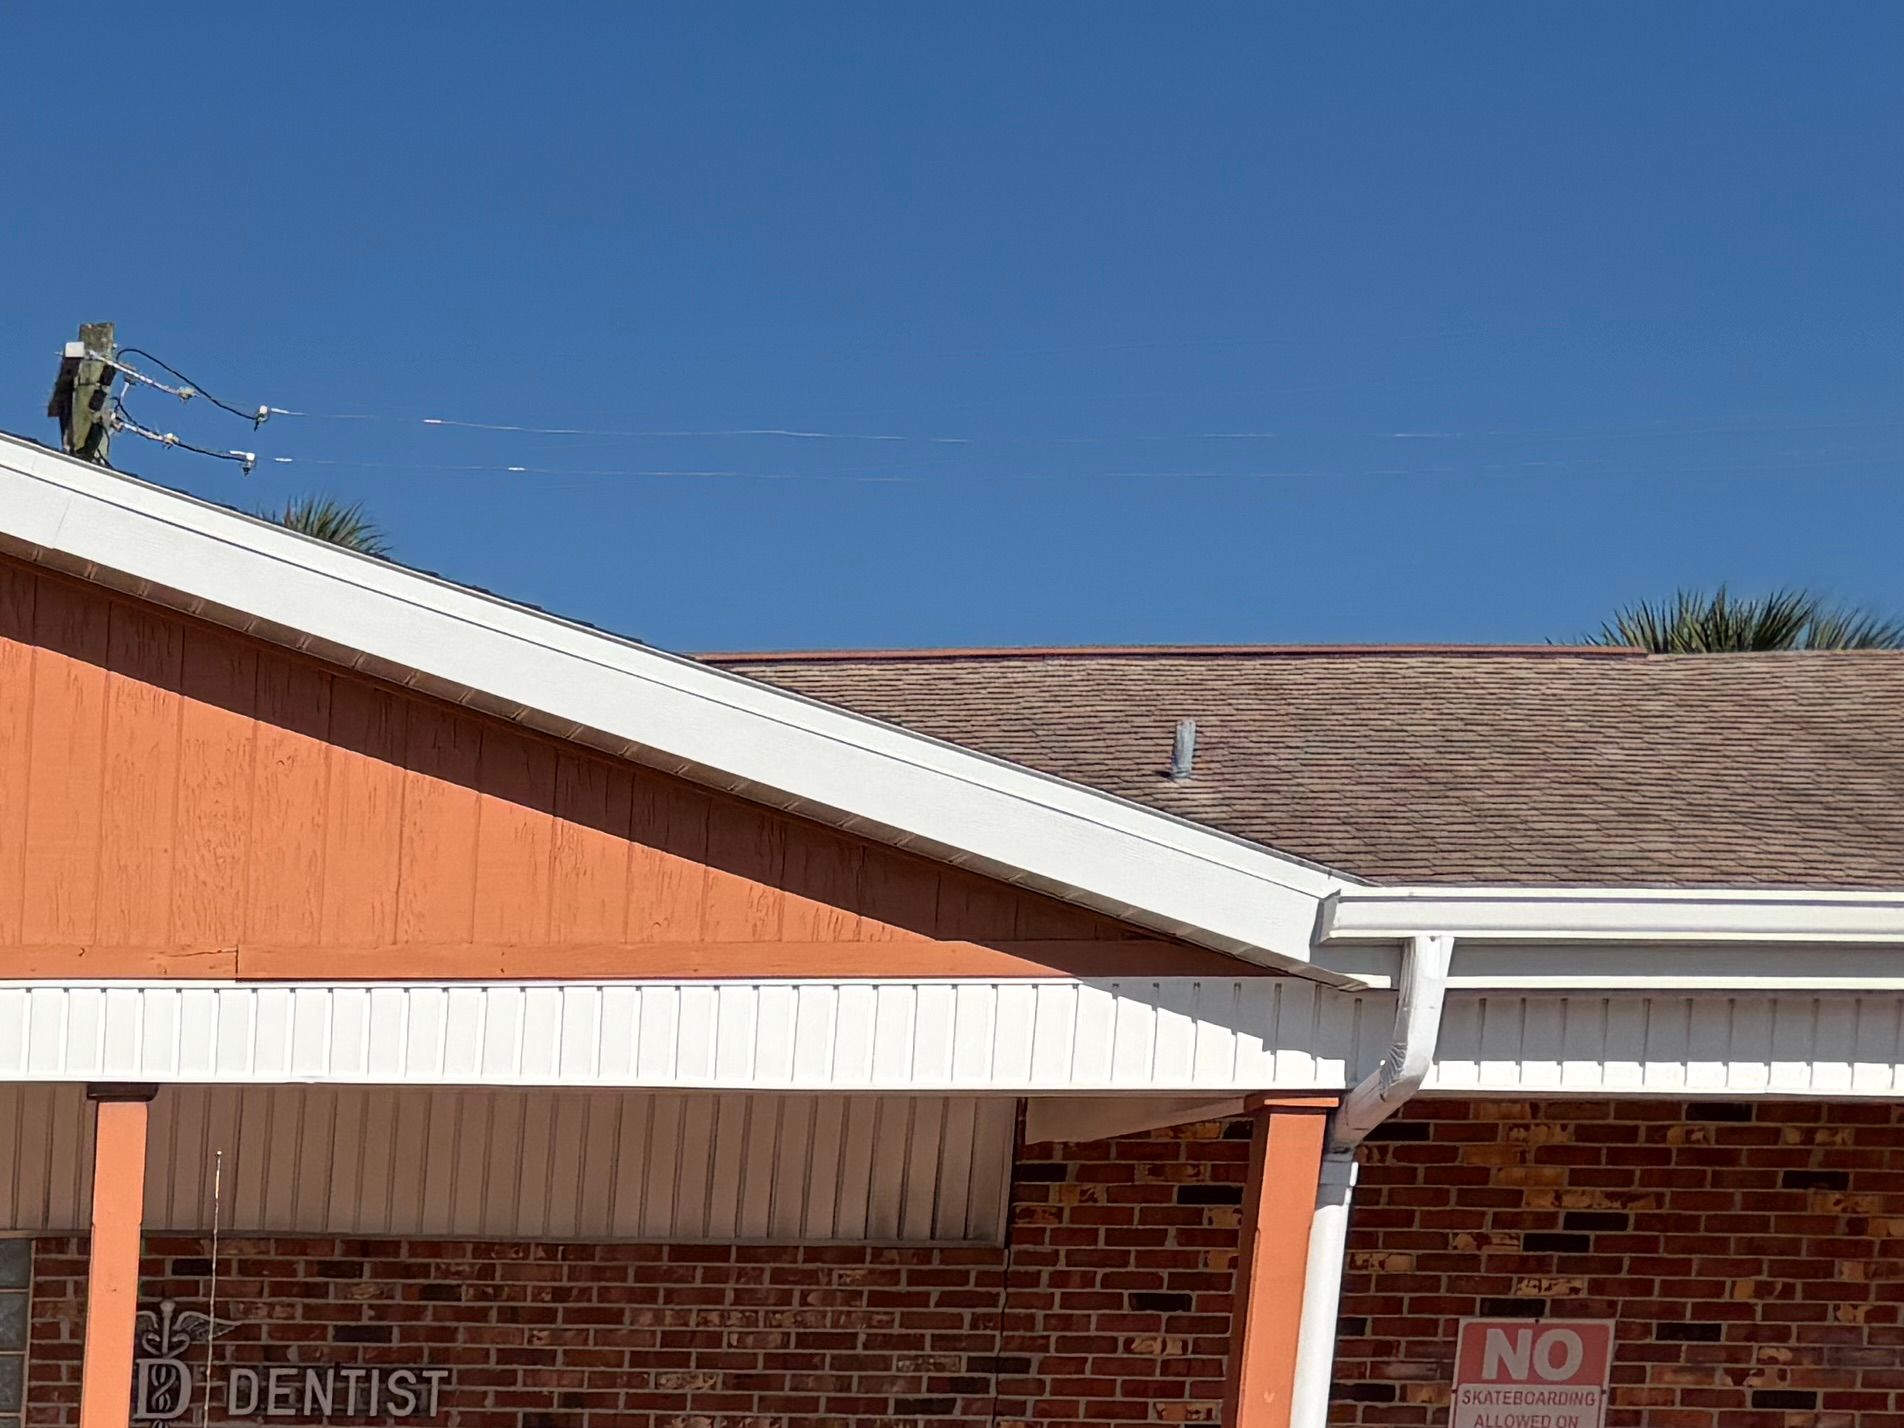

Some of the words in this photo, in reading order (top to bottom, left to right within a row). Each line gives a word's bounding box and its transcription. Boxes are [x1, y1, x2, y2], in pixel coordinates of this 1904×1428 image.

[1482, 1328, 1584, 1381] NO
[228, 1367, 449, 1417] DENTIST
[1462, 1390, 1596, 1406] SKATEBOARDING
[1474, 1413, 1551, 1428] ALLOWED
